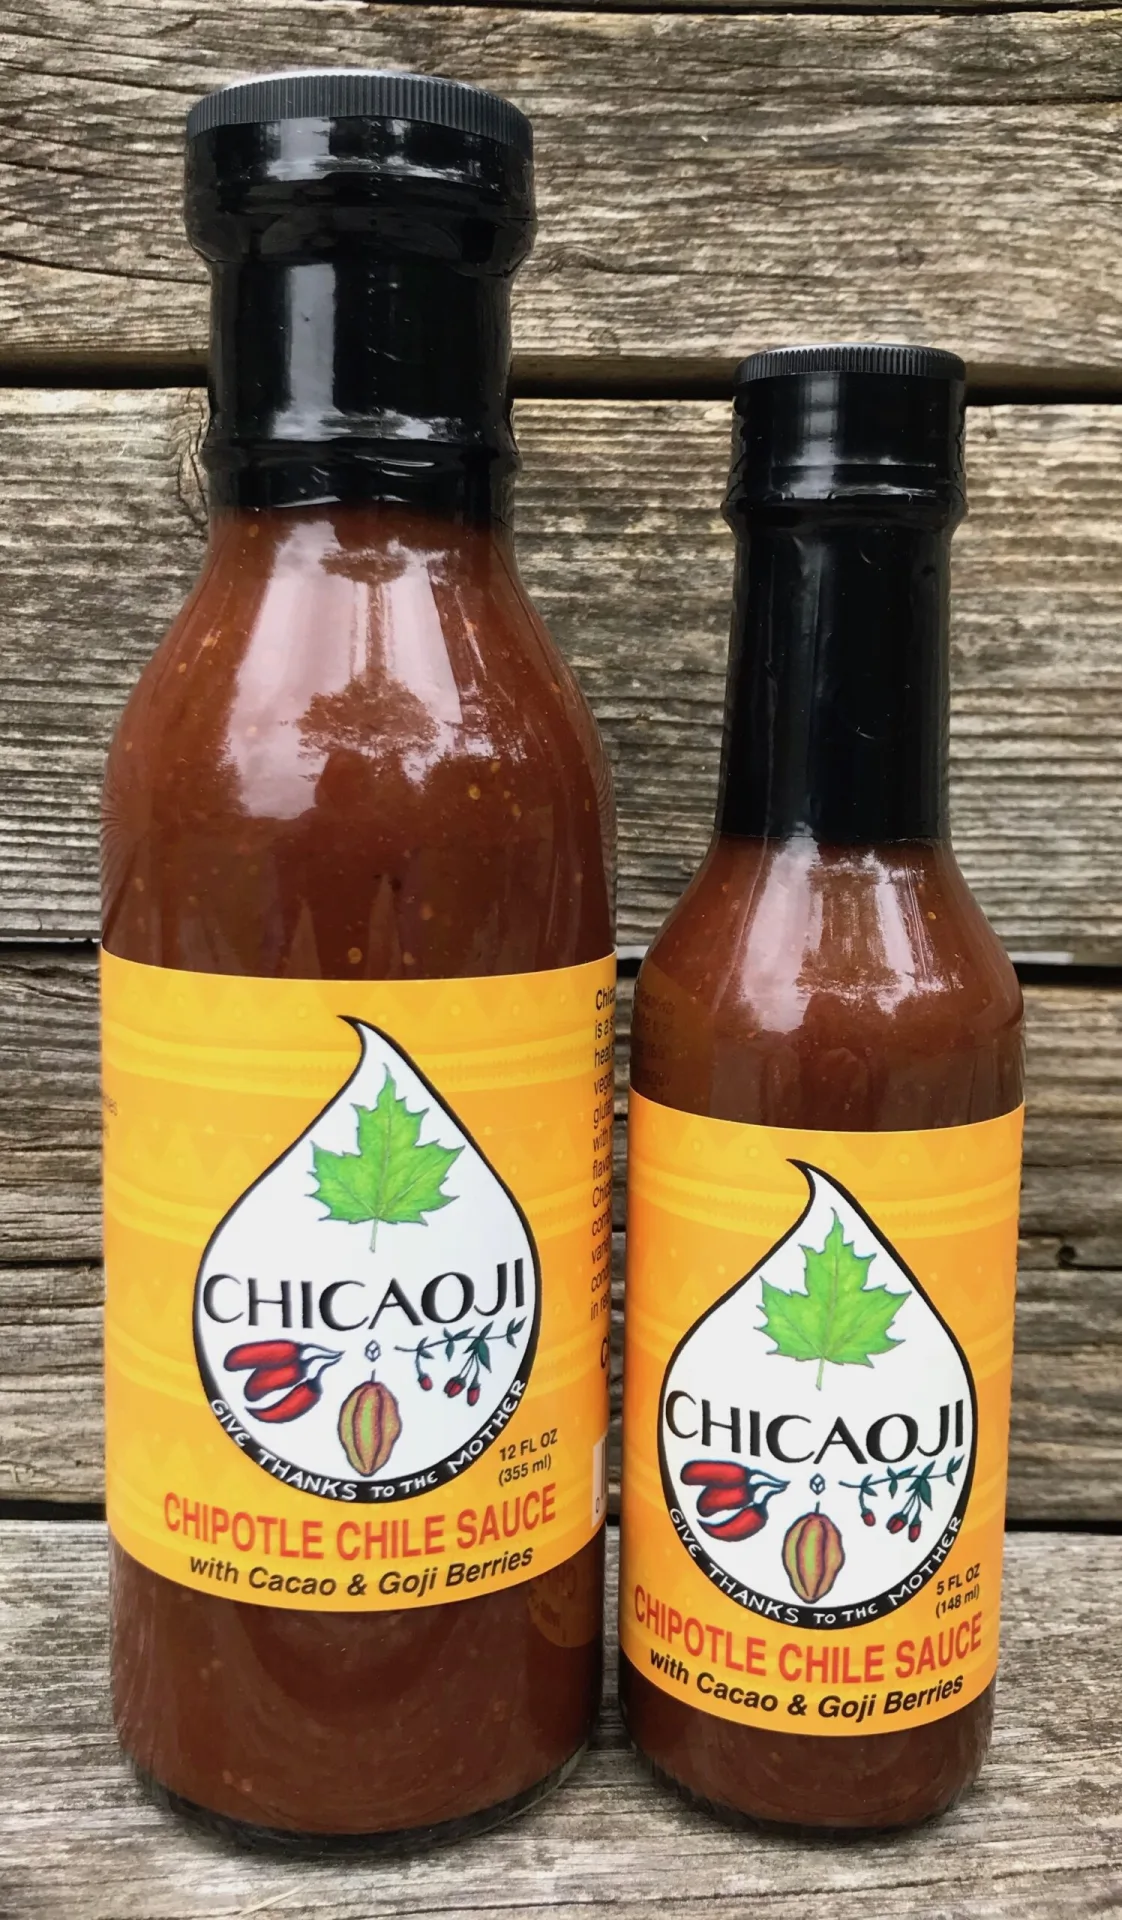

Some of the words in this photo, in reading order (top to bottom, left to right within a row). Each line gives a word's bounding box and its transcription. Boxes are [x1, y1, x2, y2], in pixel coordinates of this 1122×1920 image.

[203, 1257, 526, 1332] CHICAOJI
[211, 1399, 249, 1446] GIVE
[257, 1449, 358, 1501] THANKS
[370, 1484, 396, 1499] TO
[399, 1470, 439, 1495] THE
[447, 1378, 526, 1476] MOTHER
[499, 1444, 516, 1461] 12
[520, 1438, 538, 1457] FL
[541, 1428, 558, 1448] OZ
[665, 1389, 964, 1465] CHICAOJI
[498, 1462, 529, 1487] (355
[531, 1453, 552, 1476] ml)
[163, 1491, 325, 1560] CHIPOTLE
[336, 1514, 446, 1561] CHILE
[456, 1482, 557, 1550] SAUCE
[189, 1555, 239, 1585] with
[248, 1565, 337, 1596] Cacao
[347, 1574, 367, 1596] &
[378, 1567, 438, 1598] Goji
[445, 1546, 534, 1588] Berries
[670, 1508, 700, 1557] GIVE
[707, 1562, 800, 1625] THANKS
[812, 1612, 837, 1625] TO
[841, 1603, 878, 1622] THE
[888, 1515, 962, 1607] MOTHER
[935, 1581, 945, 1597] 5
[948, 1574, 963, 1592] FL
[965, 1563, 981, 1582] OZ
[935, 1594, 962, 1619] (148
[963, 1584, 980, 1607] ml)
[634, 1584, 767, 1677] CHIPOTLE
[778, 1644, 885, 1684] CHILE
[895, 1612, 982, 1680] SAUCE
[650, 1648, 689, 1685] with
[696, 1671, 778, 1713] Cacao
[787, 1694, 807, 1716] &
[817, 1694, 876, 1724] Goji
[883, 1674, 963, 1715] Berries
